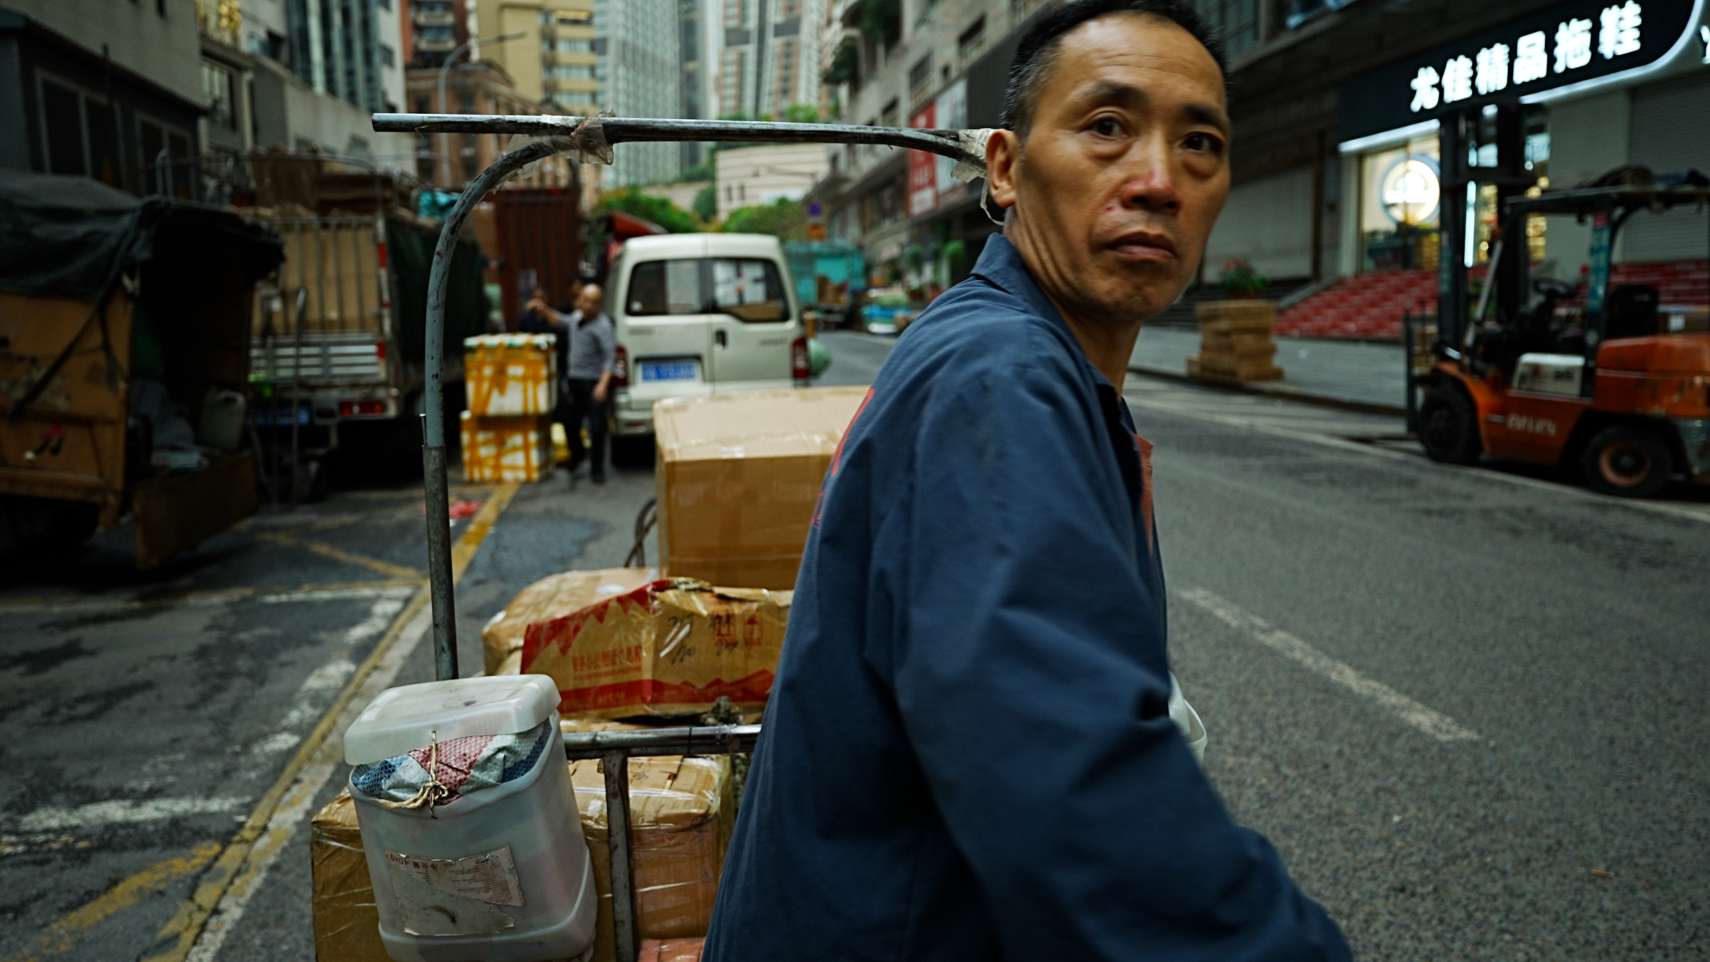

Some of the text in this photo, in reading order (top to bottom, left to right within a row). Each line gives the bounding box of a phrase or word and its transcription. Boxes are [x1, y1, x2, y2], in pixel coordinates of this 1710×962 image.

[1410, 0, 1642, 112] 尤佳精品拖鞋
